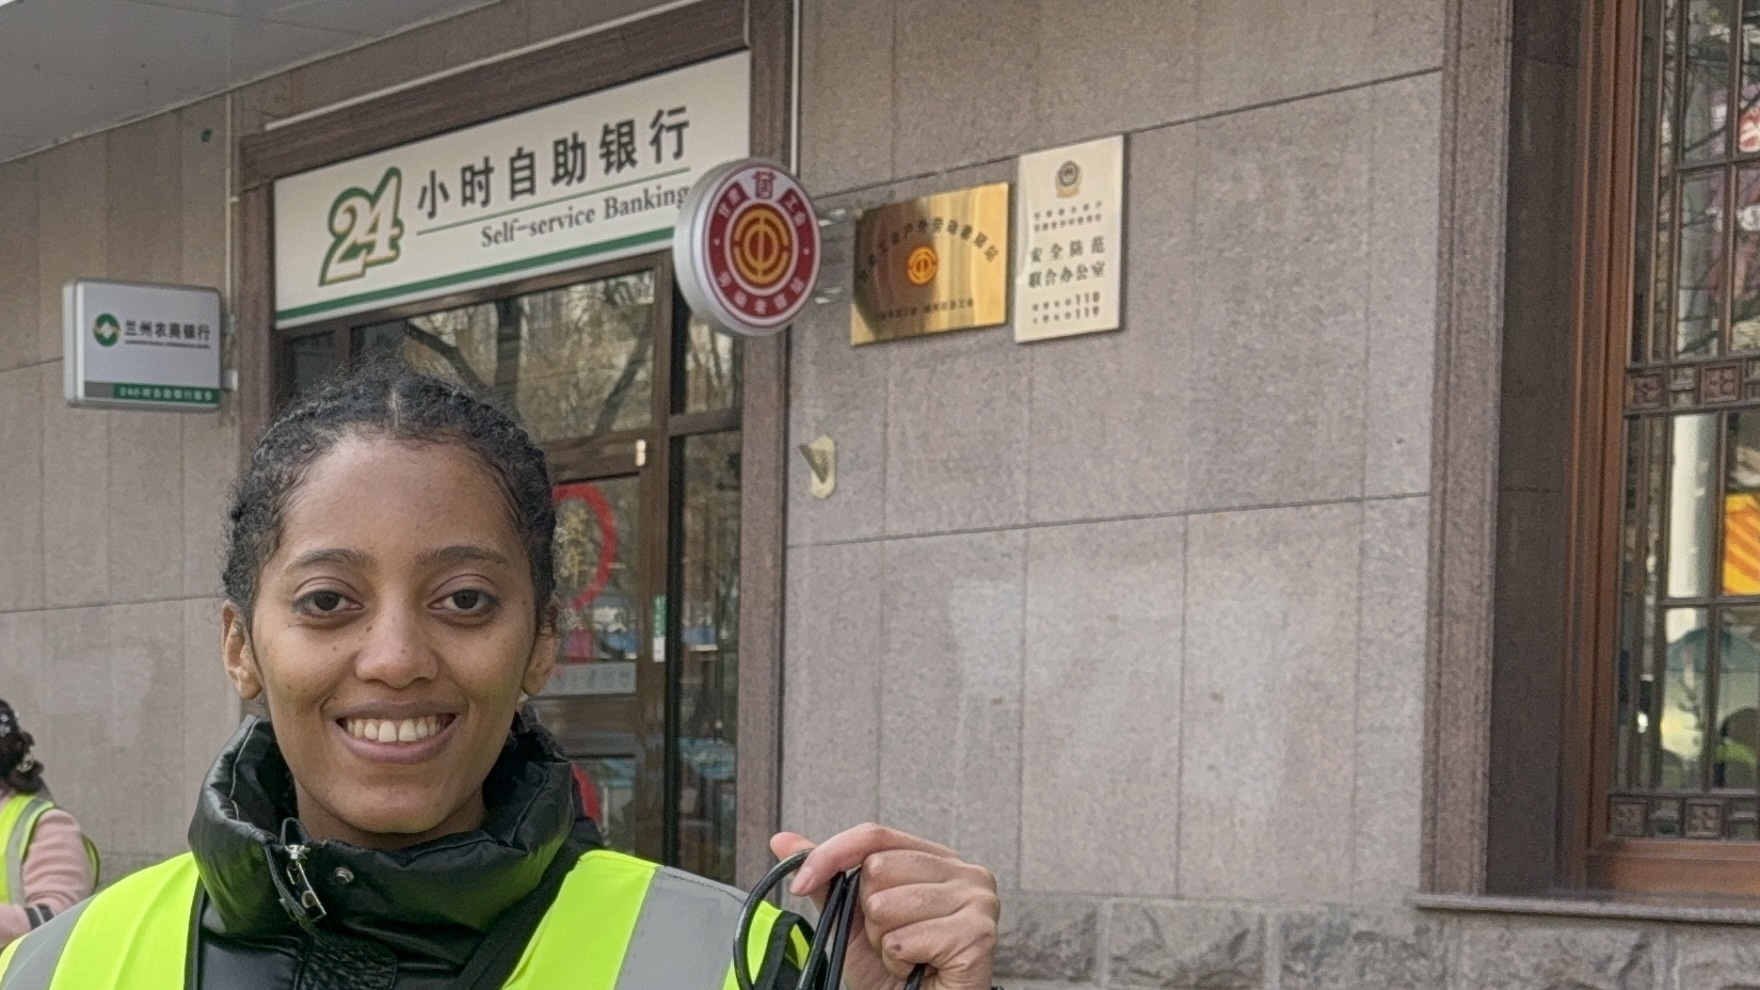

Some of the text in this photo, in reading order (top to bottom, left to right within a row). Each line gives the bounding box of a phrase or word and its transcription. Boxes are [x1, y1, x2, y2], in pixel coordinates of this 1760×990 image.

[319, 105, 690, 286] 24 小时自助银行
[480, 182, 690, 248] Self-service Banking
